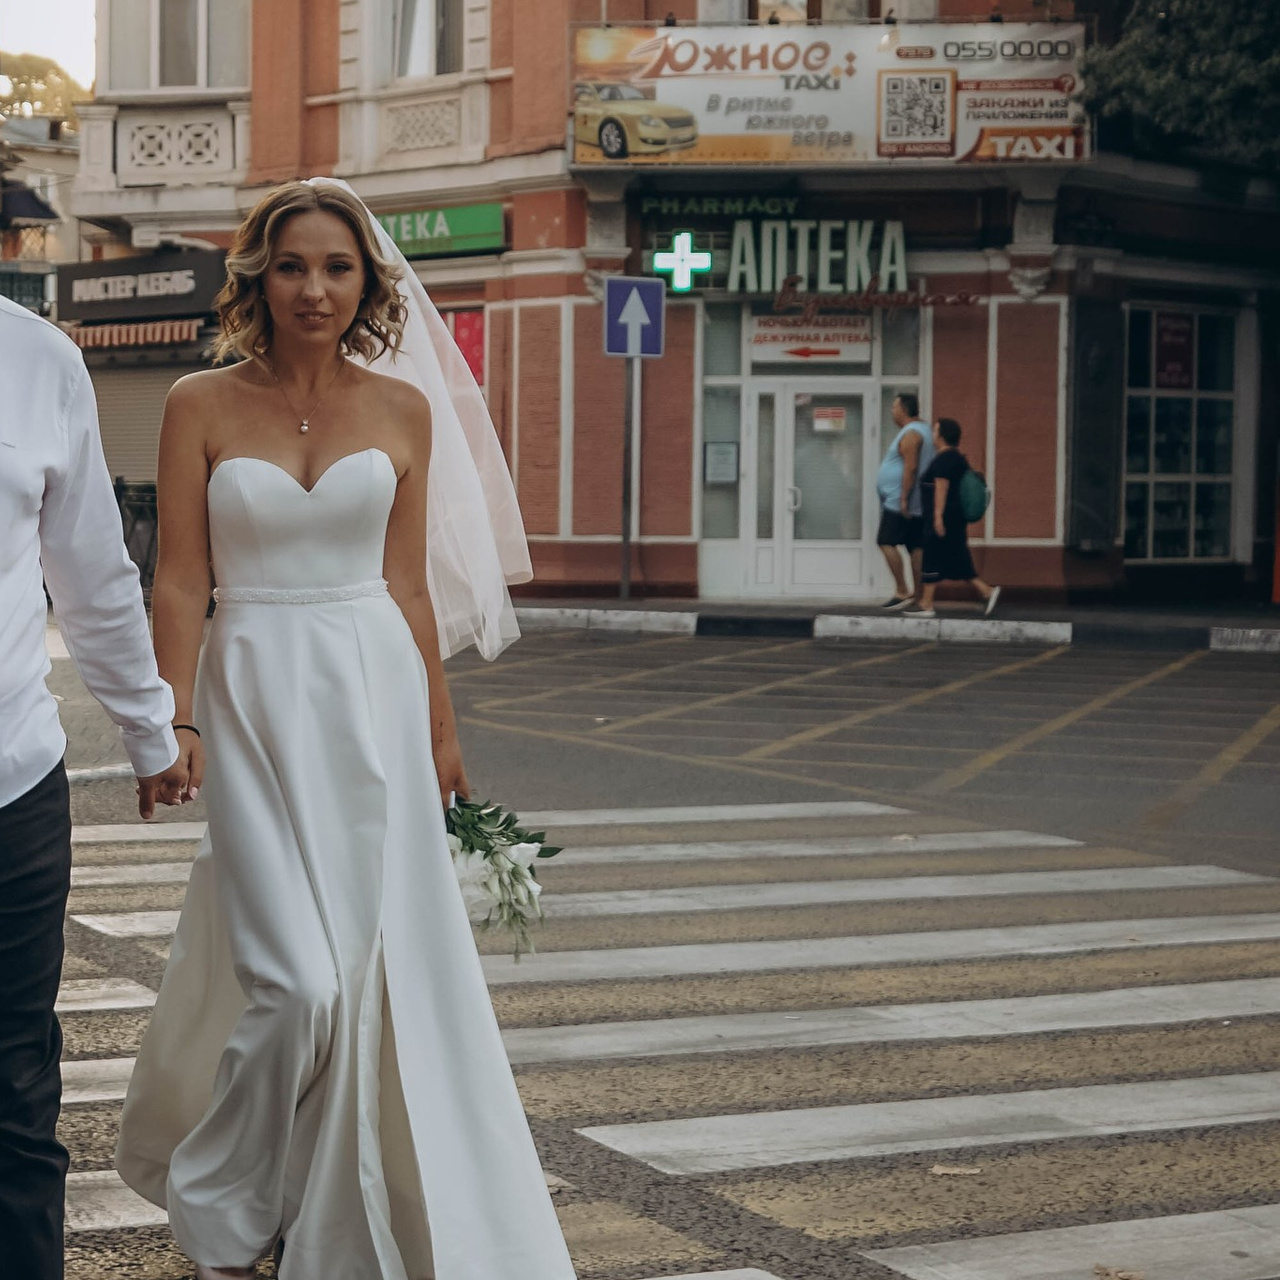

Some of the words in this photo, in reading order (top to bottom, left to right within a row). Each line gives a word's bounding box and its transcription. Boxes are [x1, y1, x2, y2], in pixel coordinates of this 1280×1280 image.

[637, 35, 832, 79] Южное
[966, 98, 1045, 108] ЗАКАЖИ
[727, 220, 909, 293] АПТЕКА
